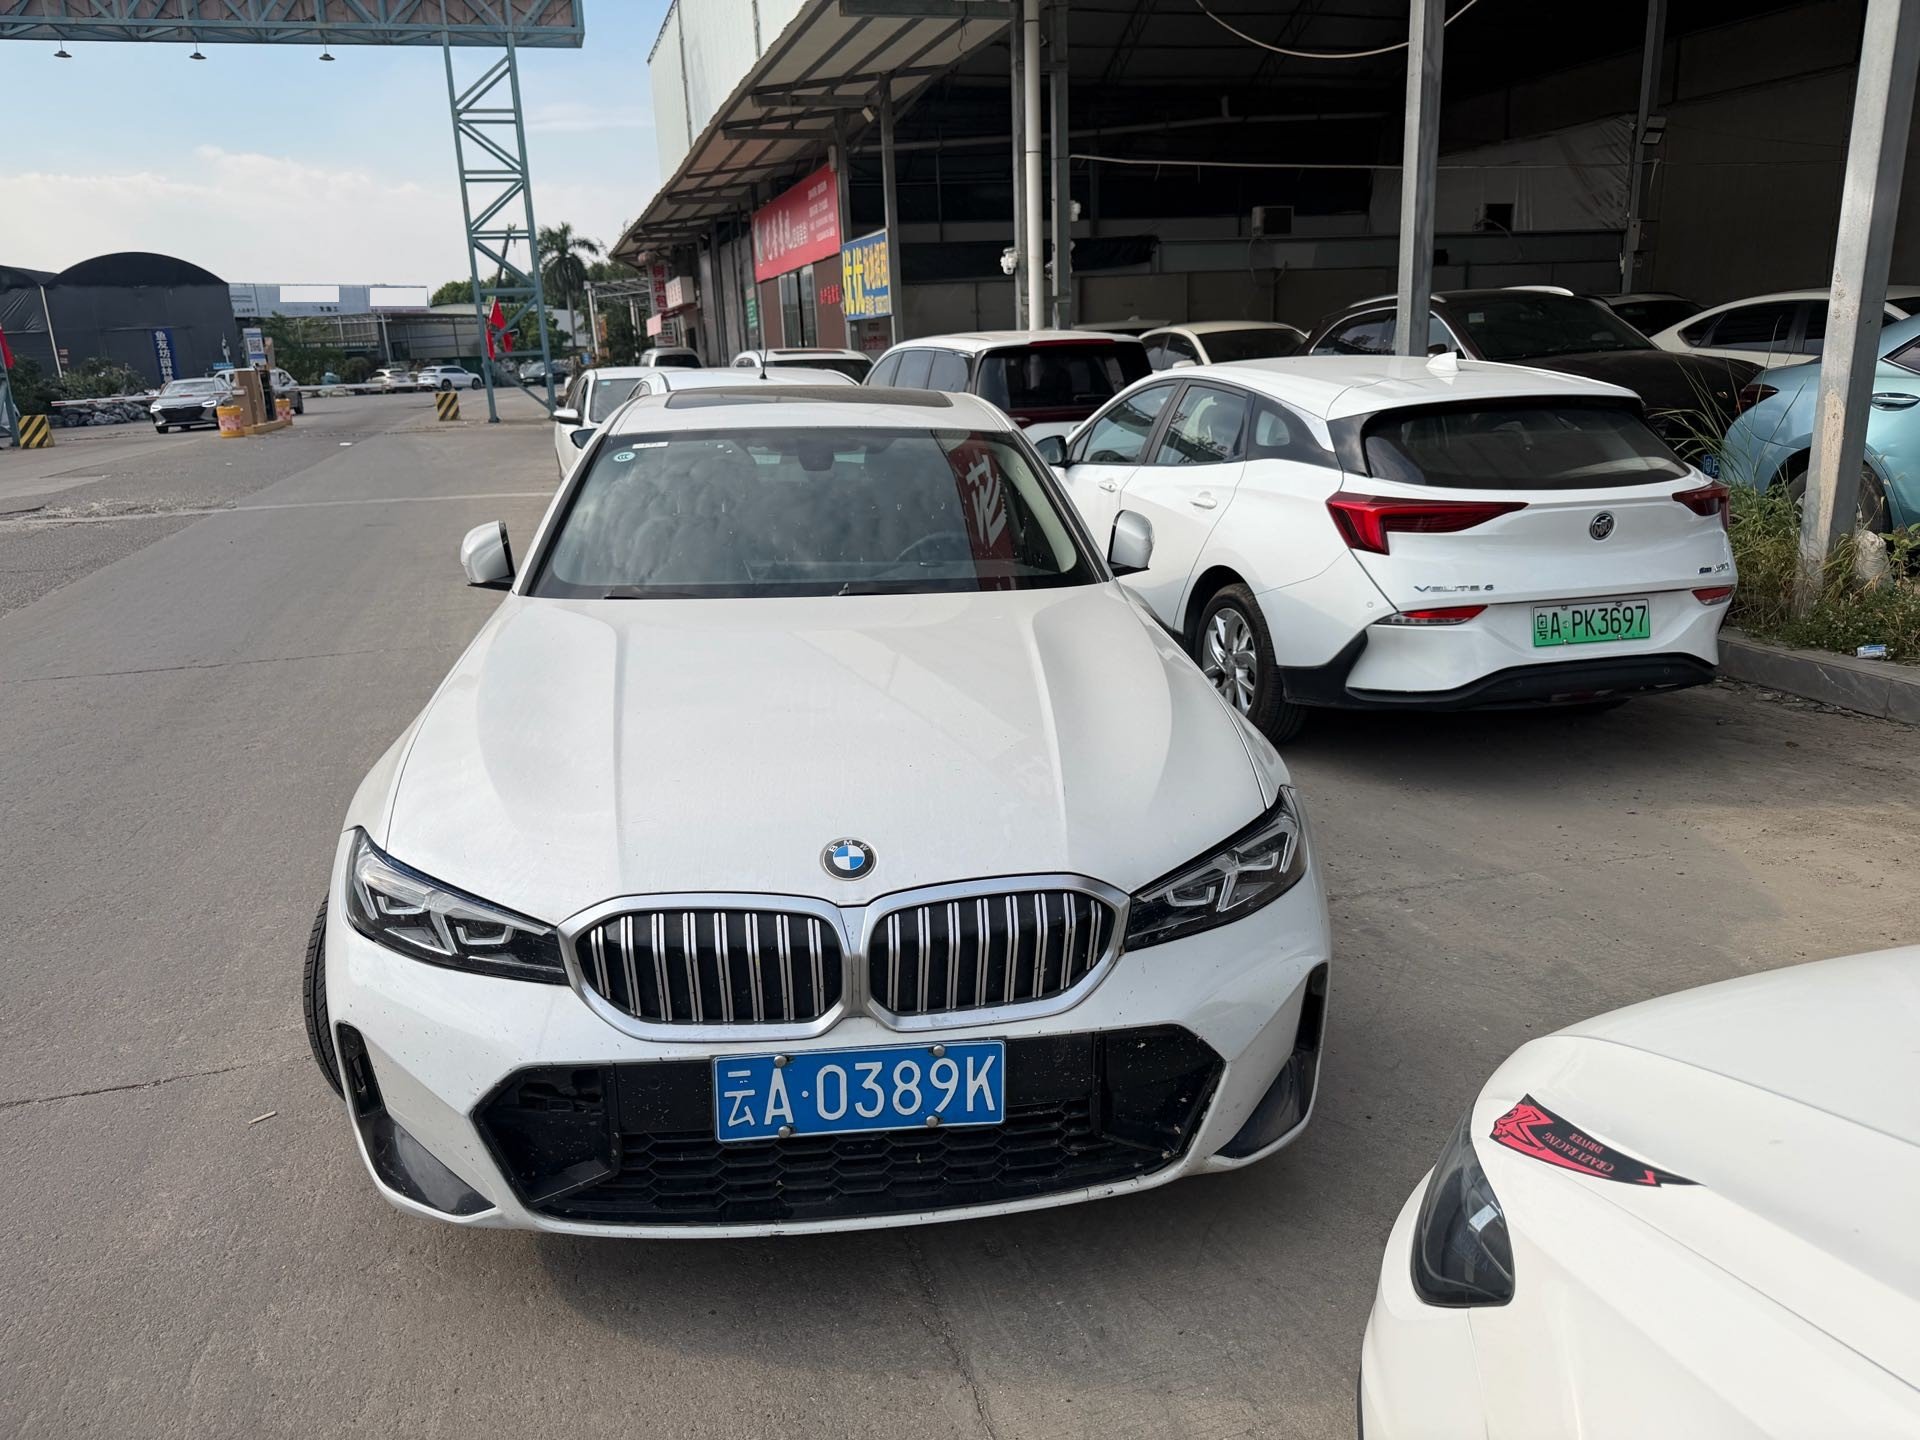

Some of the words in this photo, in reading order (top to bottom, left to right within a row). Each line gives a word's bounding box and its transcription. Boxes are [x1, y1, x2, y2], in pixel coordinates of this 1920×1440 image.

[1414, 584, 1480, 593] VELITE
[828, 840, 869, 852] BMW
[724, 1055, 996, 1127] 云A·0389K
[1542, 1132, 1578, 1158] RACING
[1569, 1132, 1604, 1154] DRIVER
[1577, 1152, 1614, 1172] CRAZY
